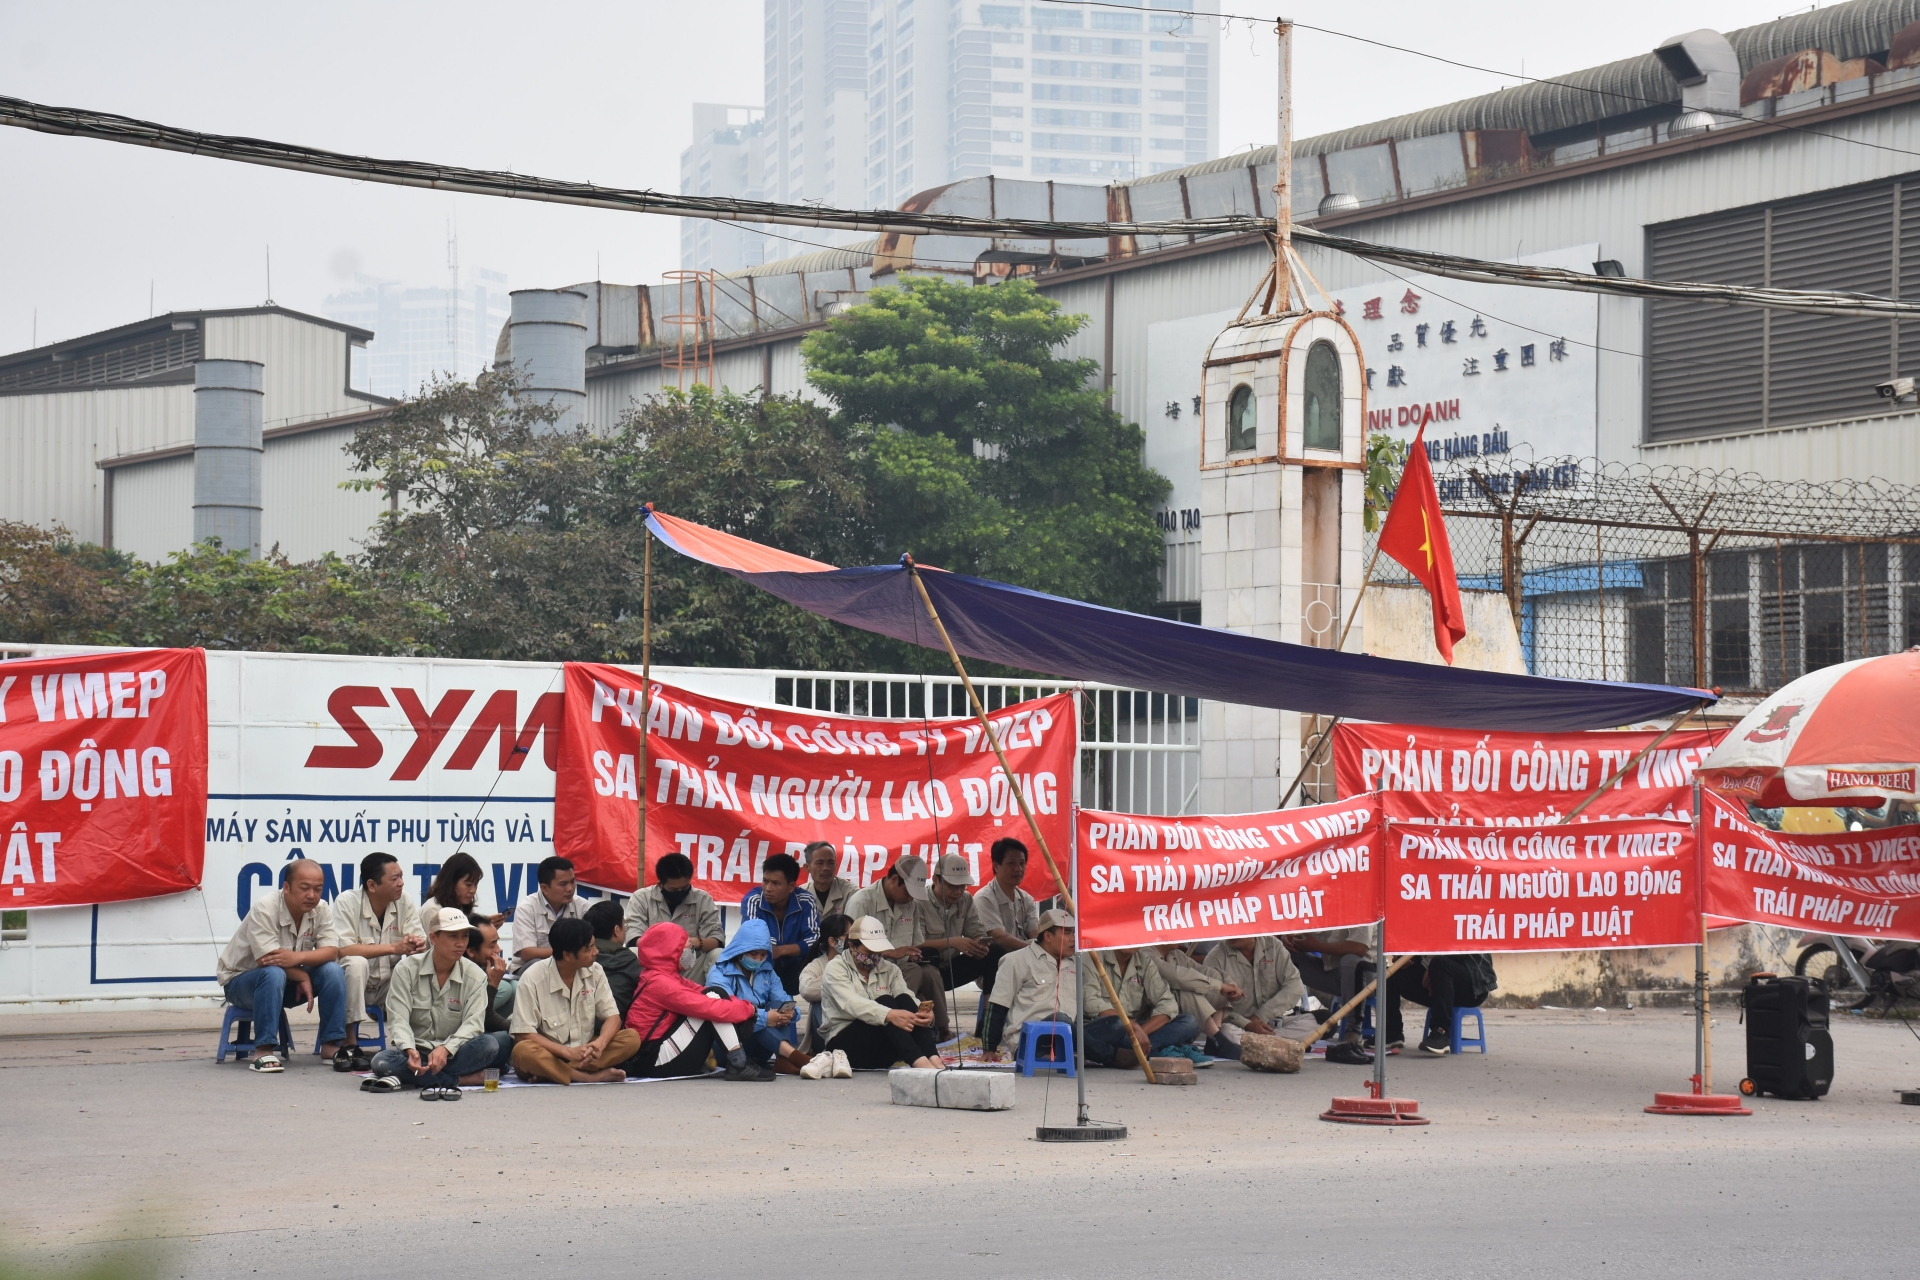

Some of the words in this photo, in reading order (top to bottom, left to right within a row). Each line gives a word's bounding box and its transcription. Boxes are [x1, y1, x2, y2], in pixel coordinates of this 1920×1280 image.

[1387, 314, 1488, 352] 品質優先
[1463, 337, 1570, 377] 注重團隊
[1367, 408, 1392, 430] NH
[1398, 398, 1460, 427] DOANH
[1444, 432, 1478, 461] HÀNG
[1181, 508, 1200, 534] TẠO
[31, 669, 167, 722] VMEP
[304, 685, 564, 782] SYM
[591, 679, 704, 742] PHẢN
[711, 706, 783, 750] ĐỐI
[786, 722, 901, 756] CÔNG
[900, 729, 947, 756] TY
[953, 708, 1053, 754] VMEP
[38, 739, 173, 811] ĐỘNG
[1362, 734, 1443, 792] PHẢN
[1451, 735, 1500, 792] ĐỐI
[1510, 741, 1589, 791] CÔNG
[1598, 750, 1631, 790] TY
[1830, 772, 1874, 788] HANOI
[1878, 772, 1911, 790] BEER
[593, 750, 639, 801] SA
[655, 755, 743, 812] THẢI
[750, 769, 871, 821] NGƯỜI
[880, 778, 953, 821] LAO
[960, 766, 1058, 827] ĐỘNG
[206, 811, 258, 842] MÁY
[265, 808, 312, 844] SẢN
[318, 810, 381, 843] XUẤT
[387, 818, 430, 847] PHỤ
[436, 813, 495, 843] TÙNG
[505, 813, 535, 842] VÀ
[540, 819, 555, 842] L
[1090, 817, 1158, 850] PHẢN
[1207, 825, 1269, 850] CÔNG
[1267, 823, 1301, 845] TY
[1301, 808, 1371, 840] VMEP
[1400, 828, 1466, 860] PHẢN
[1468, 829, 1508, 860] ĐỐI
[1513, 831, 1576, 860] CÔNG
[1584, 835, 1611, 858] TY
[1617, 832, 1682, 857] VMEP
[675, 830, 770, 884] TRÁI
[1090, 865, 1125, 893] SA
[1131, 857, 1186, 892] THẢI
[1193, 856, 1264, 890] NGƯỜI
[1261, 855, 1302, 880] LAO
[1306, 844, 1370, 879] ĐỘNG
[1713, 842, 1736, 869] SA
[1875, 870, 1920, 898] ĐỘN
[1780, 841, 1835, 866] CÔNG
[1834, 843, 1862, 864] TY
[1866, 836, 1920, 862] VMEP
[1400, 874, 1431, 900] SA
[1439, 865, 1492, 899] THẢI
[1500, 866, 1569, 898] NGƯỜI
[1577, 872, 1617, 897] LAO
[1624, 865, 1681, 900] ĐỘNG
[1143, 898, 1193, 931] TRÁI
[1199, 891, 1262, 926] PHÁP
[1270, 886, 1324, 923] LUẬT
[1454, 908, 1506, 940] TRÁI
[1514, 907, 1574, 939] PHÁP
[1582, 906, 1633, 941] LUẬT
[1754, 887, 1796, 916] TRÁI
[1800, 894, 1854, 923] PHÁP
[1854, 900, 1899, 932] LUẬT
